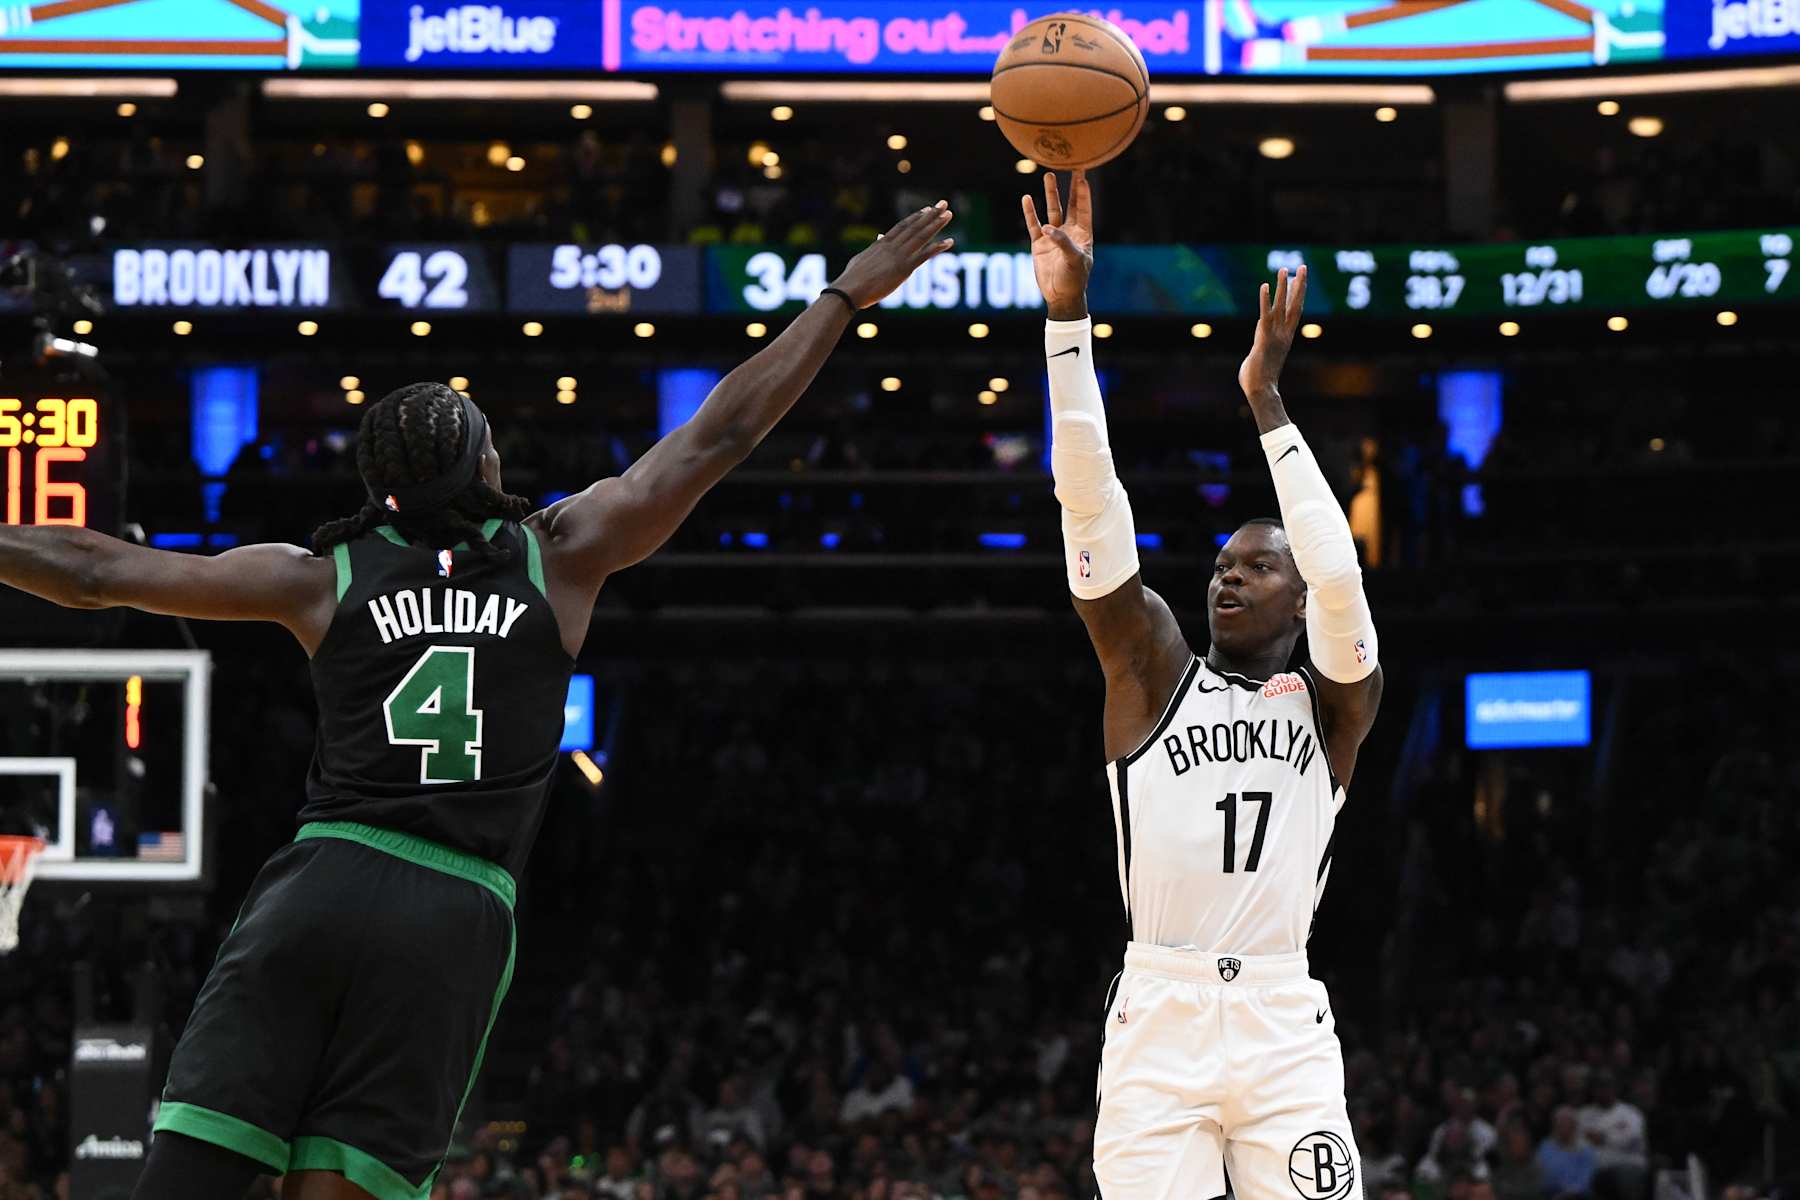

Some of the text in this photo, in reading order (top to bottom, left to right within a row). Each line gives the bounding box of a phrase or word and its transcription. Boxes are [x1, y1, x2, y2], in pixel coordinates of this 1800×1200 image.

[405, 5, 556, 61] jetBlue
[631, 6, 879, 63] Stretching
[113, 249, 330, 306] BROOKLYN
[378, 250, 468, 308] 42
[549, 243, 662, 289] 5:30
[743, 251, 830, 312] 34
[878, 252, 1045, 309] OSTON
[1501, 268, 1584, 306] 12/31
[1645, 262, 1722, 299] 6/20
[1764, 258, 1790, 293] 7
[0, 398, 98, 448] 5:30
[7, 447, 87, 528] 16
[367, 587, 529, 645] HOLIDAY
[382, 644, 483, 785] 4
[1263, 682, 1306, 698] GUIDE
[1163, 719, 1317, 776] BROOKLYN
[1215, 790, 1273, 874] 17
[1218, 958, 1240, 971] NETS
[1312, 1142, 1337, 1193] B
